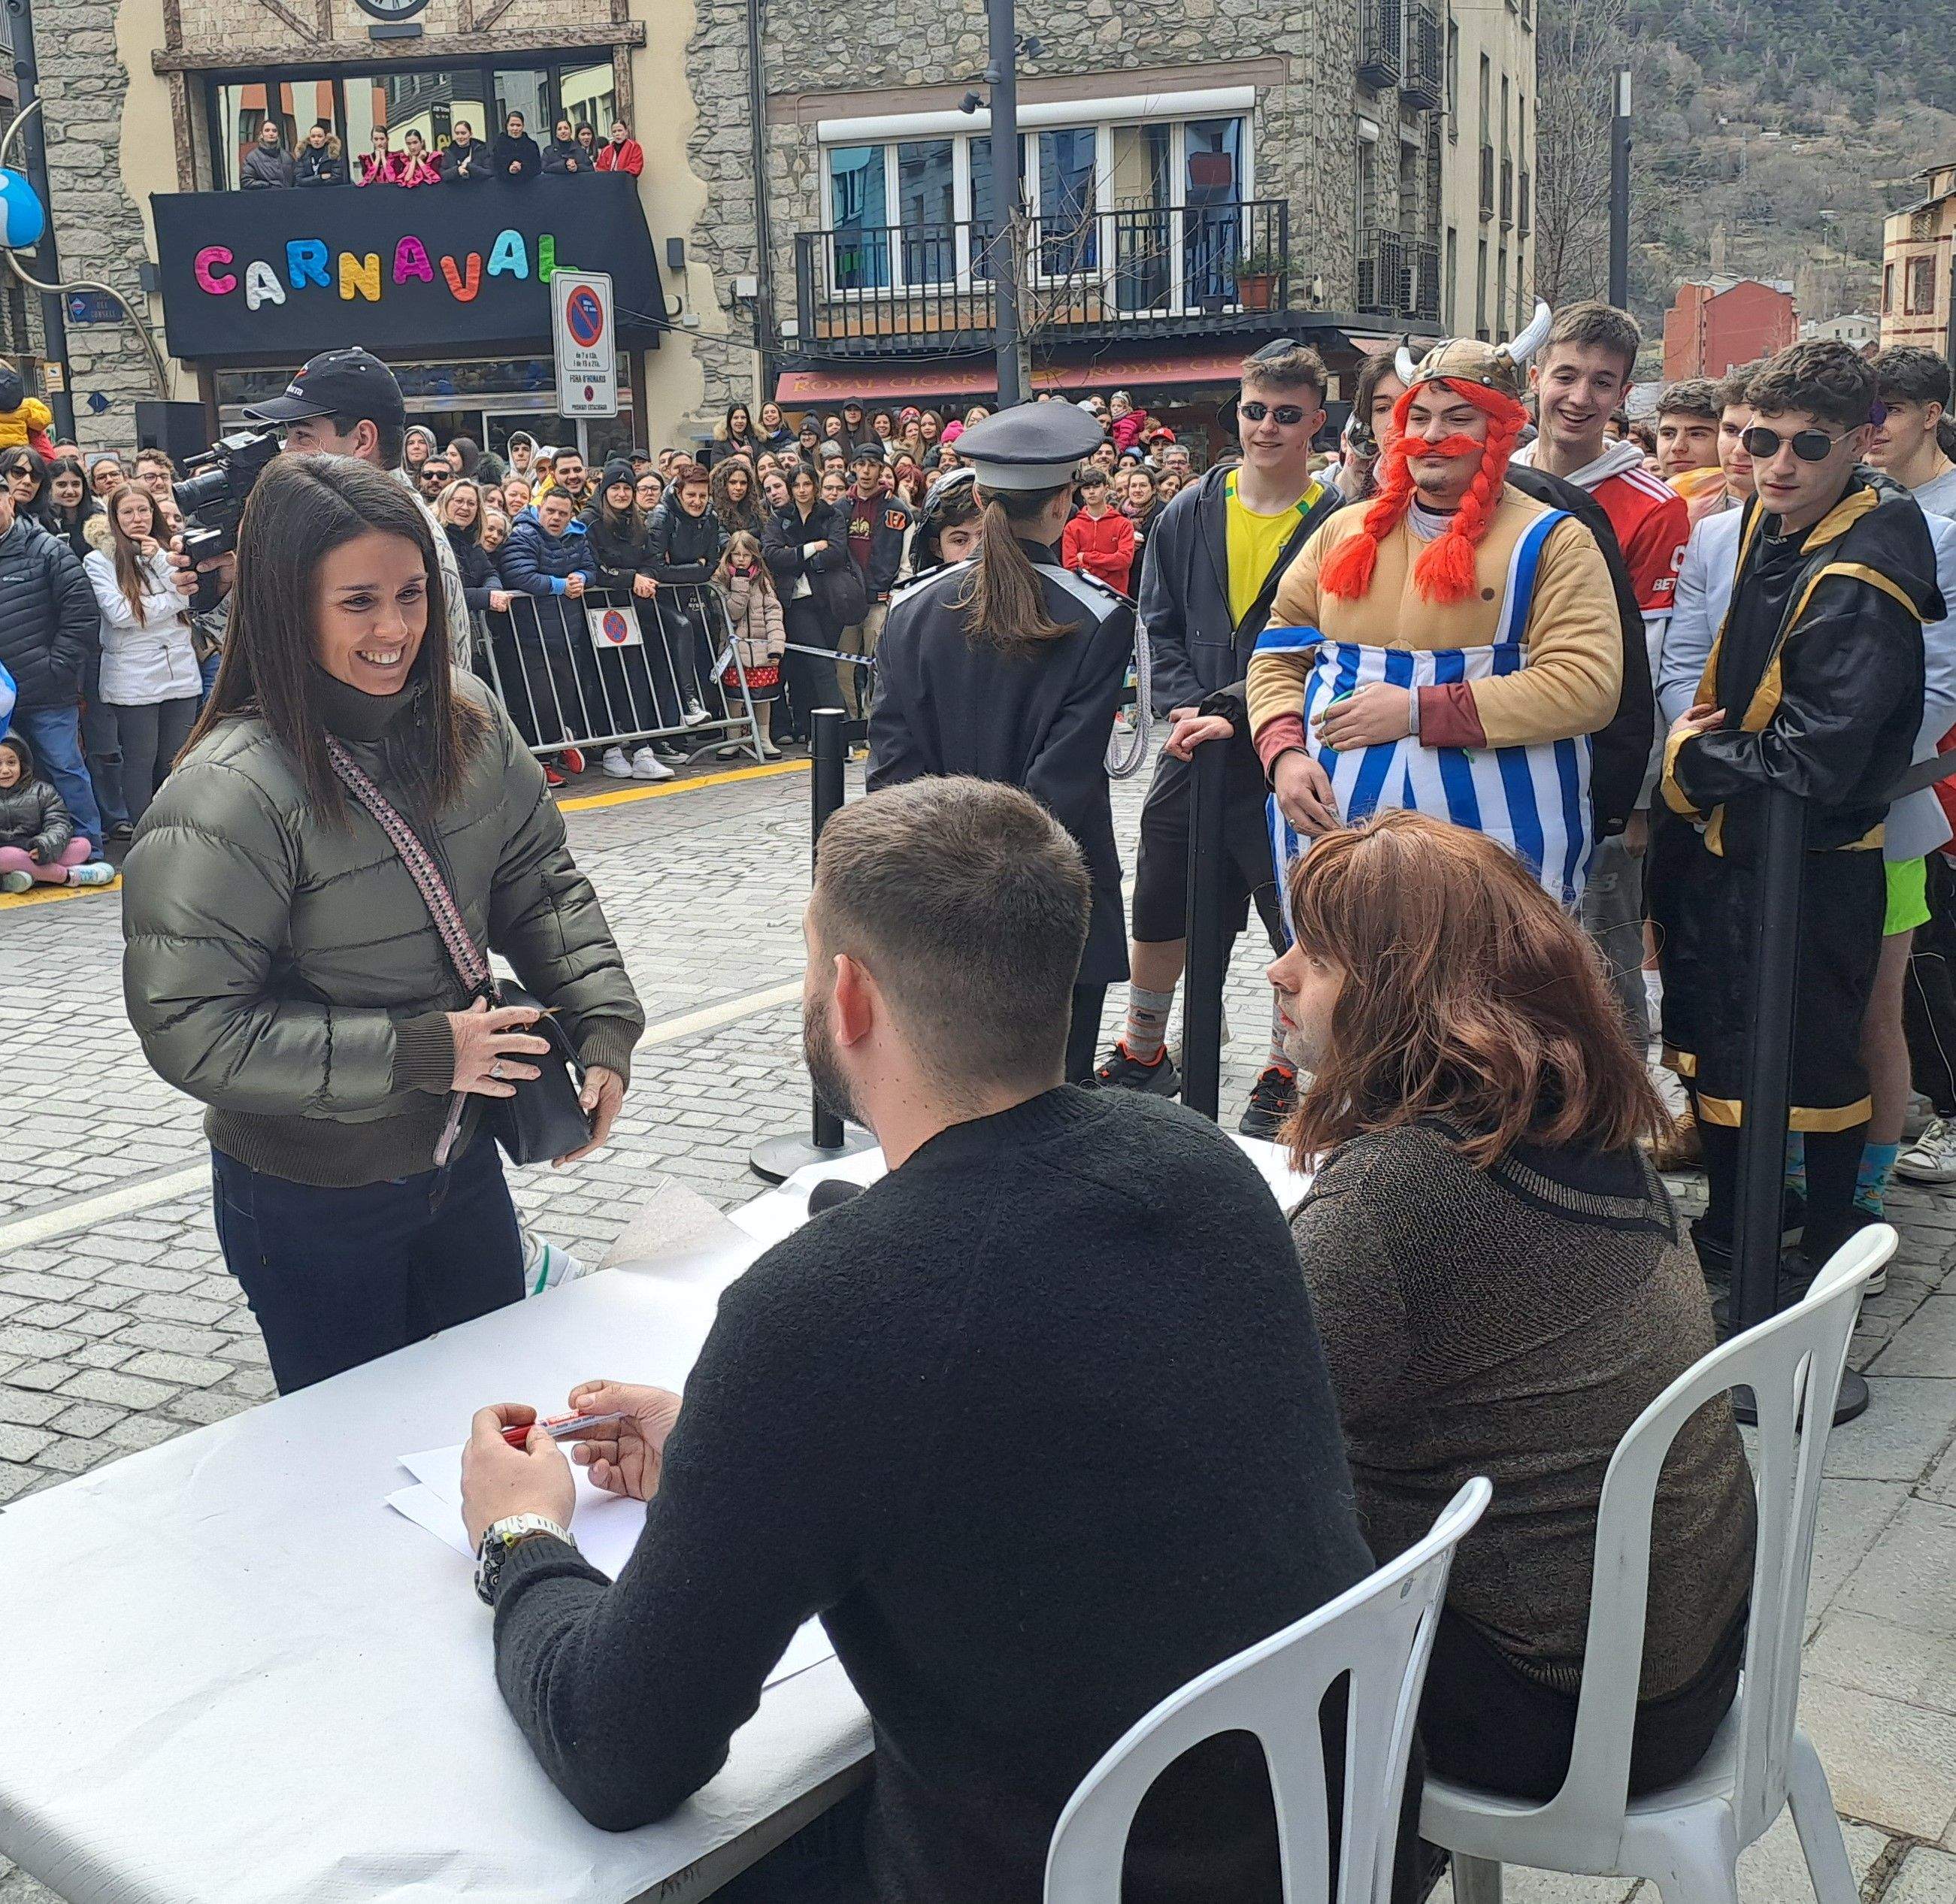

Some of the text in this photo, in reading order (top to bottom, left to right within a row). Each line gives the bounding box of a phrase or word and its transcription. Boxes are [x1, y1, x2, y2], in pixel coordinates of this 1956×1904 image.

[194, 229, 578, 311] CARNAVAL
[1090, 362, 1177, 377] ROYAL
[793, 373, 978, 392] ROYAL CIGAR
